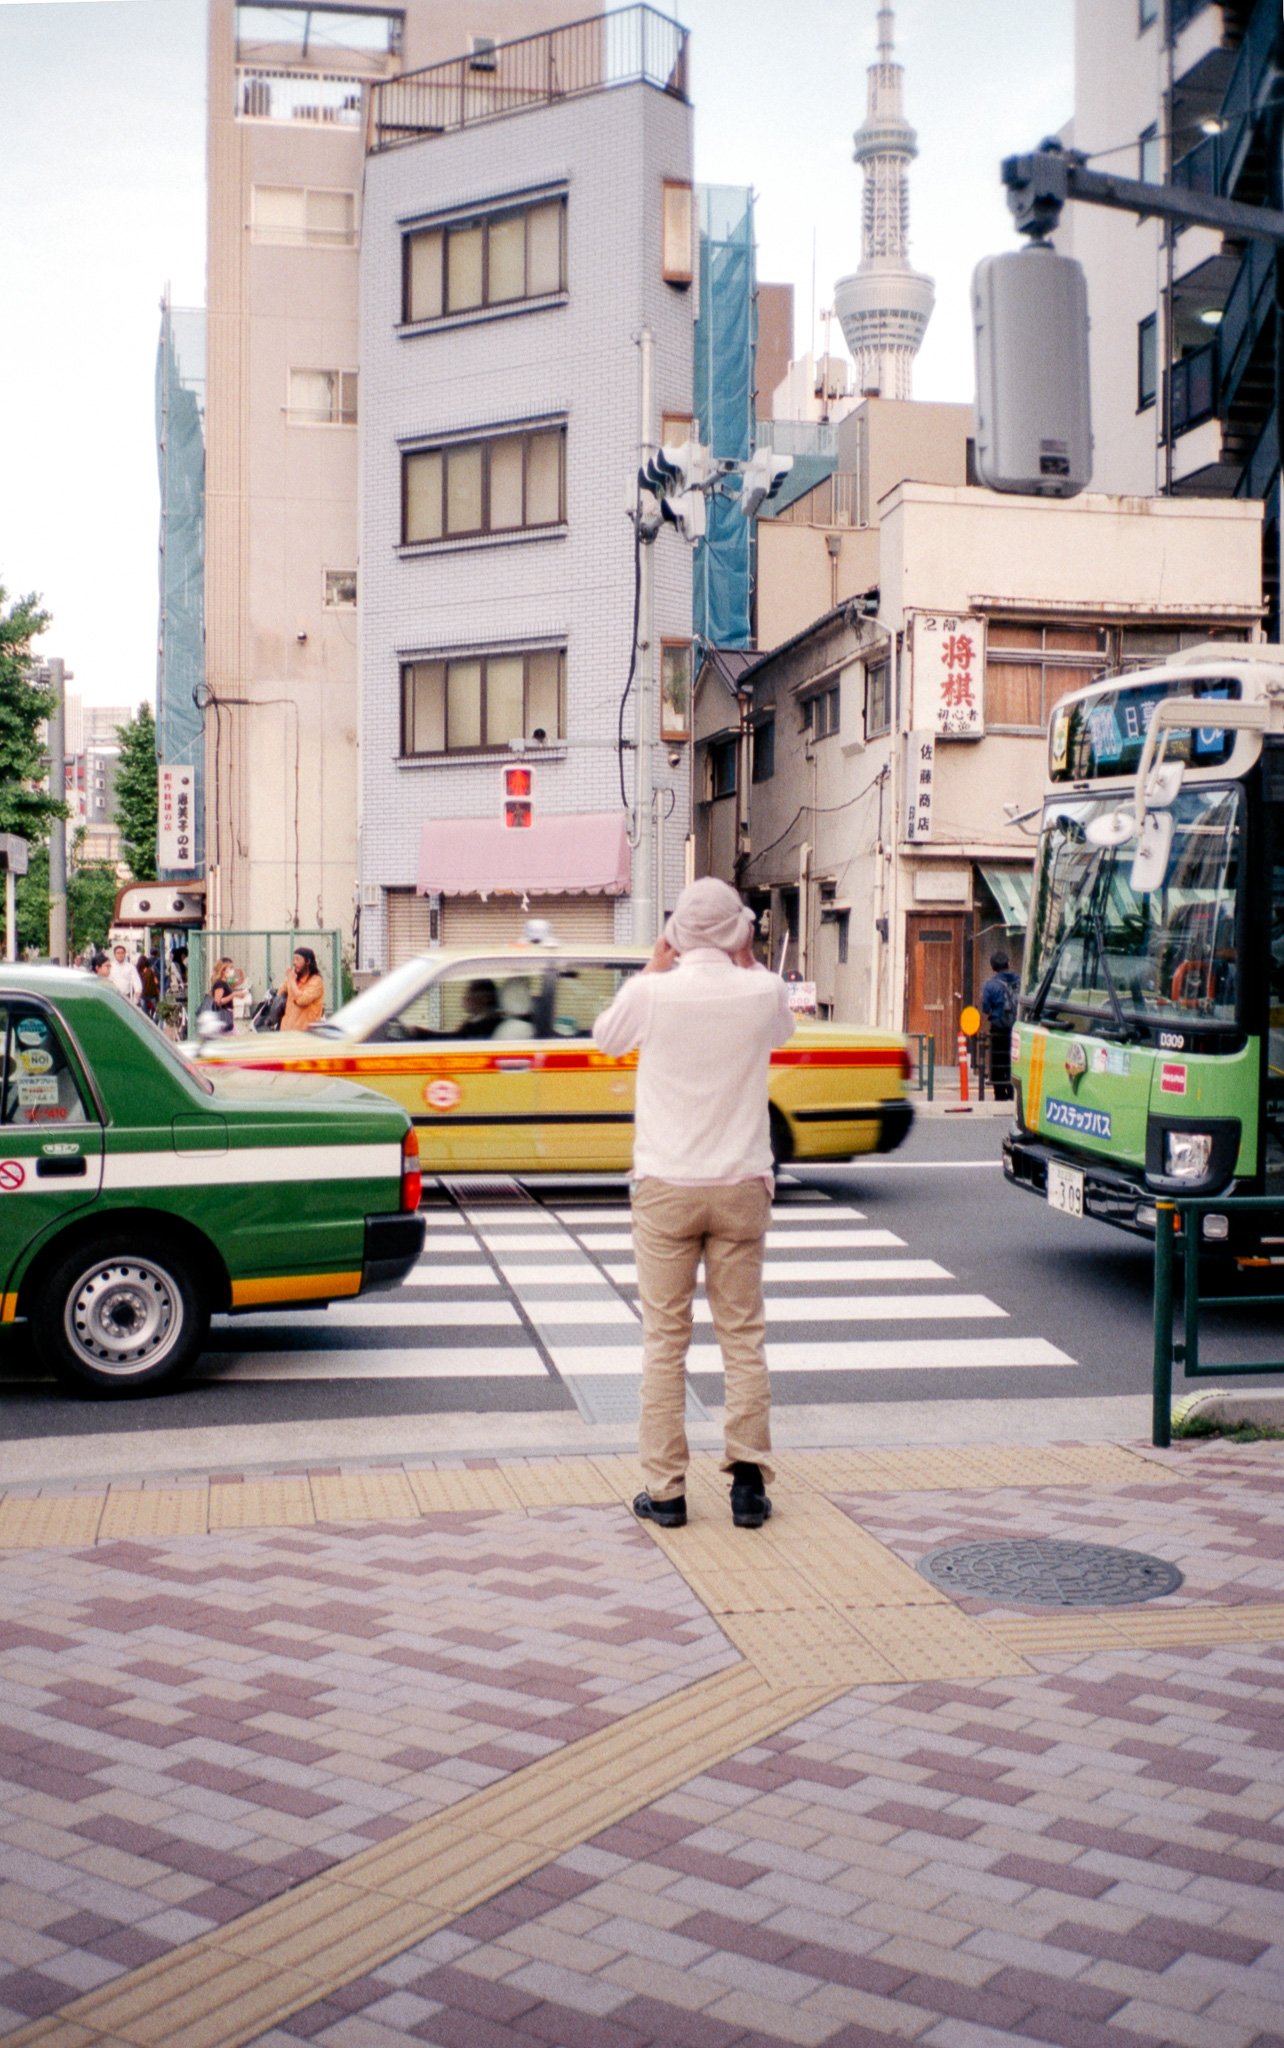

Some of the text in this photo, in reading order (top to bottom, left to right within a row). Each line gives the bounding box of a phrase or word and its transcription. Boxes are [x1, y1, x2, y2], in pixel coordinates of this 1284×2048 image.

[941, 634, 977, 707] 将棋
[938, 709, 978, 721] 初心者
[918, 744, 932, 831] 佐藤商店
[1160, 1032, 1185, 1049] D309
[31, 1055, 49, 1066] NO!
[1046, 1101, 1111, 1138] ノンステップバス
